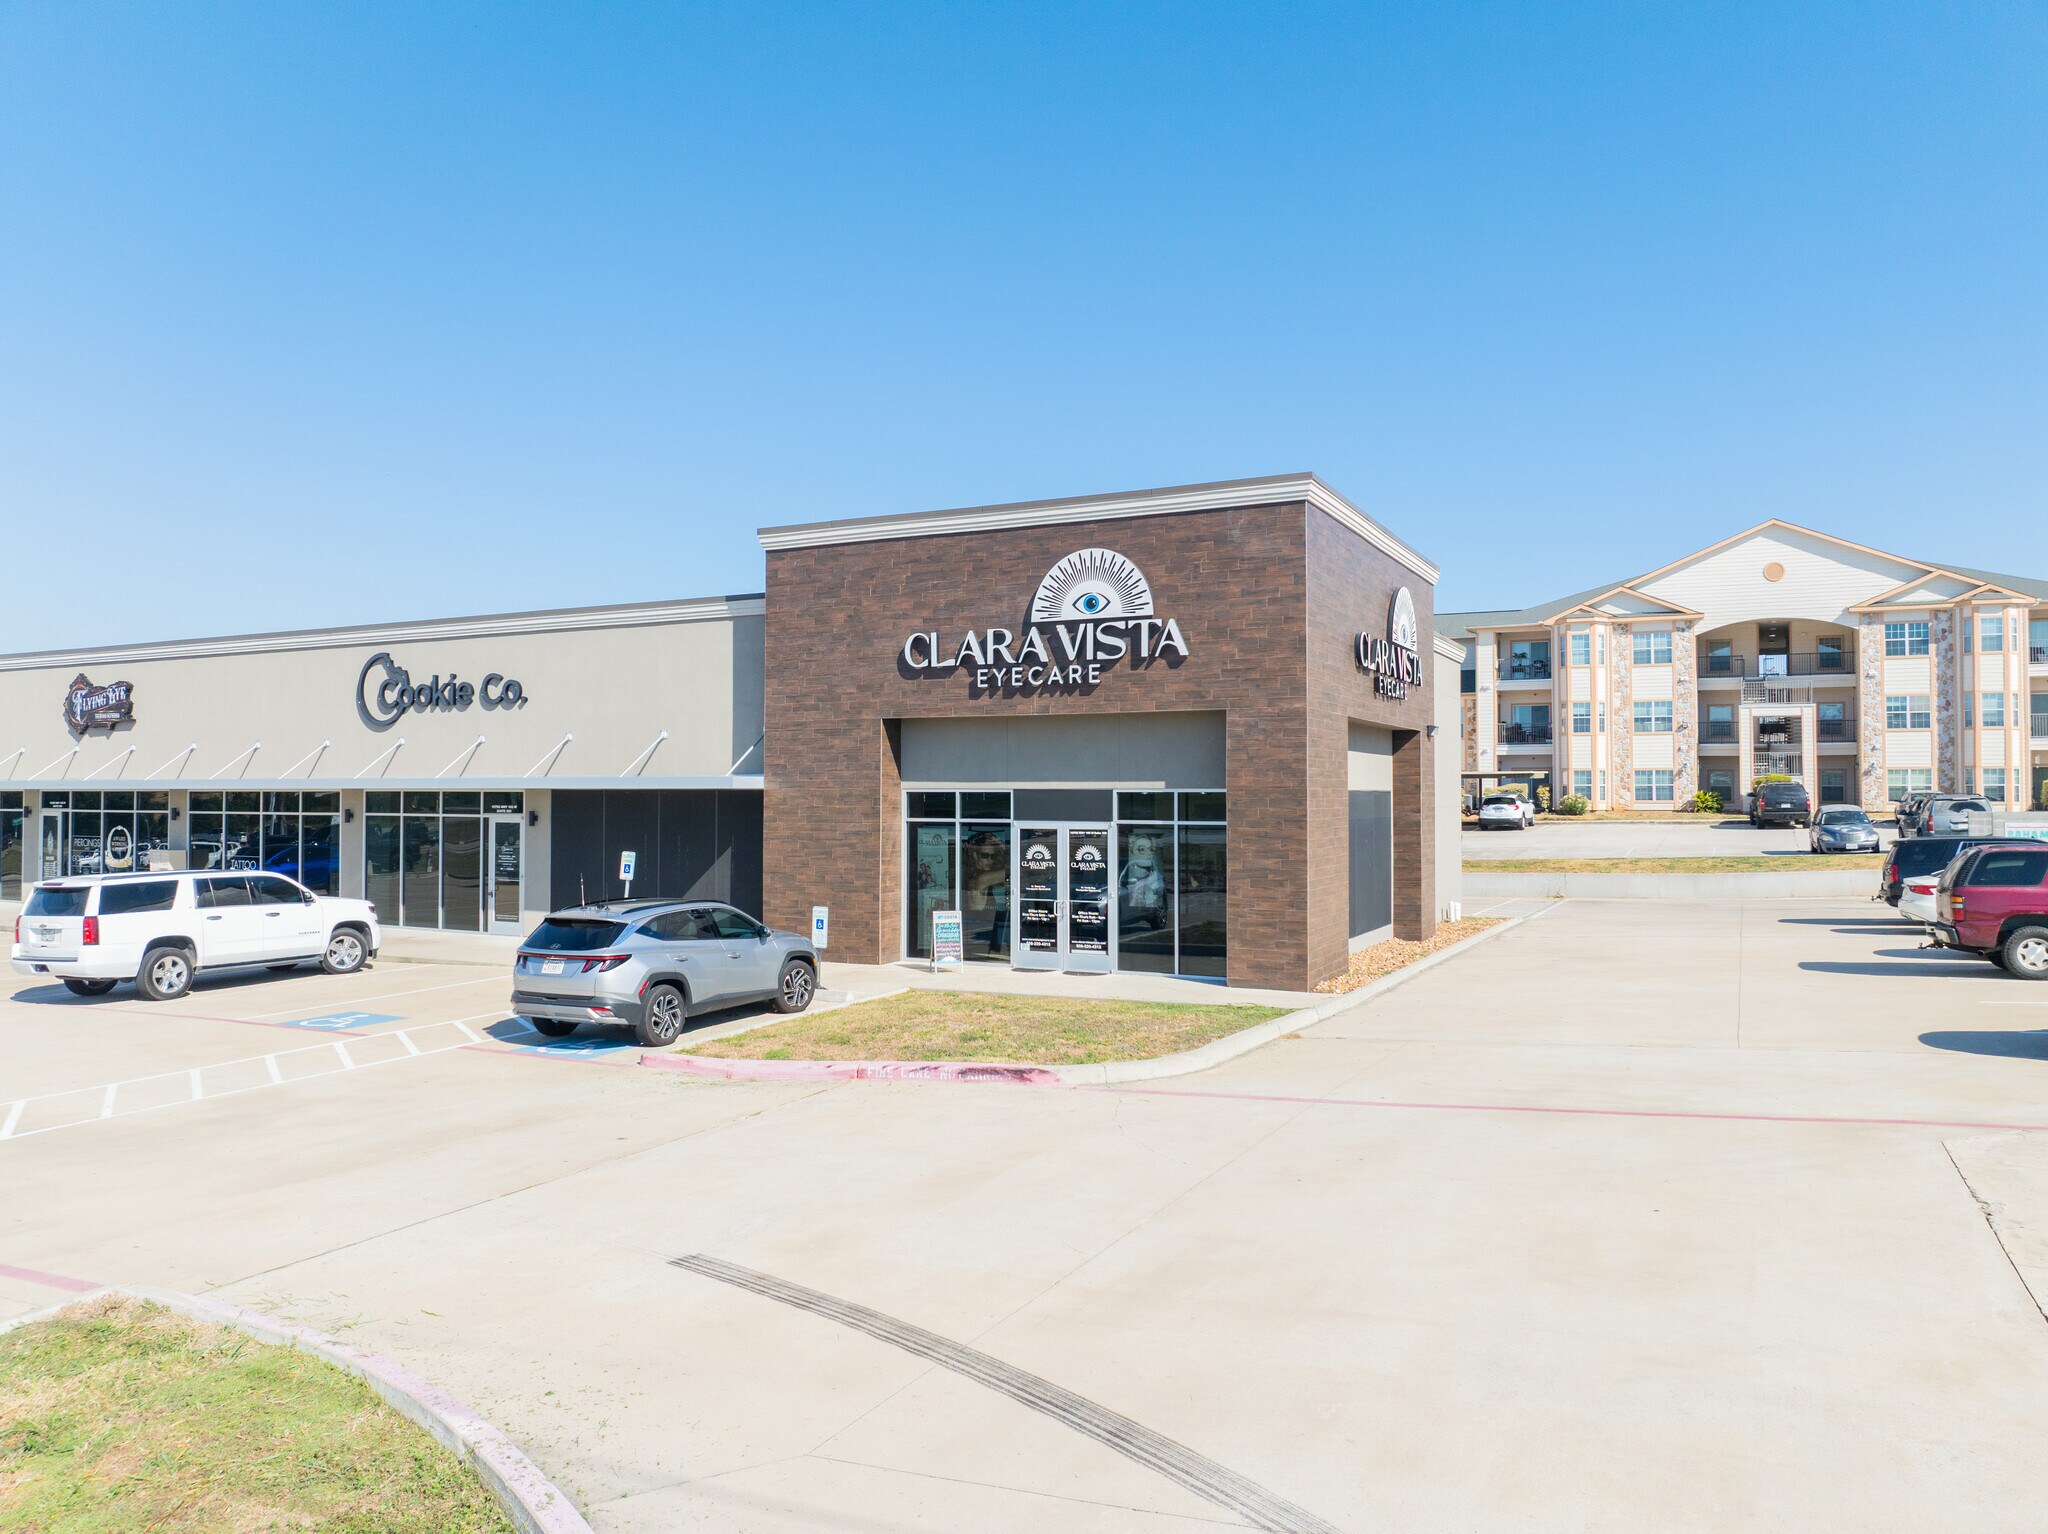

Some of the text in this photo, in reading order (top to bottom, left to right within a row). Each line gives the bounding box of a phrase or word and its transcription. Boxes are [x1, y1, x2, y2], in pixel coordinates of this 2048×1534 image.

[904, 618, 1189, 668] CLARA VISTA
[1360, 631, 1423, 687] CLARA VISTA
[480, 672, 529, 706] Co.
[977, 663, 1101, 688] EYECARE
[1379, 675, 1407, 700] EYECARE
[230, 859, 257, 870] TATTOO
